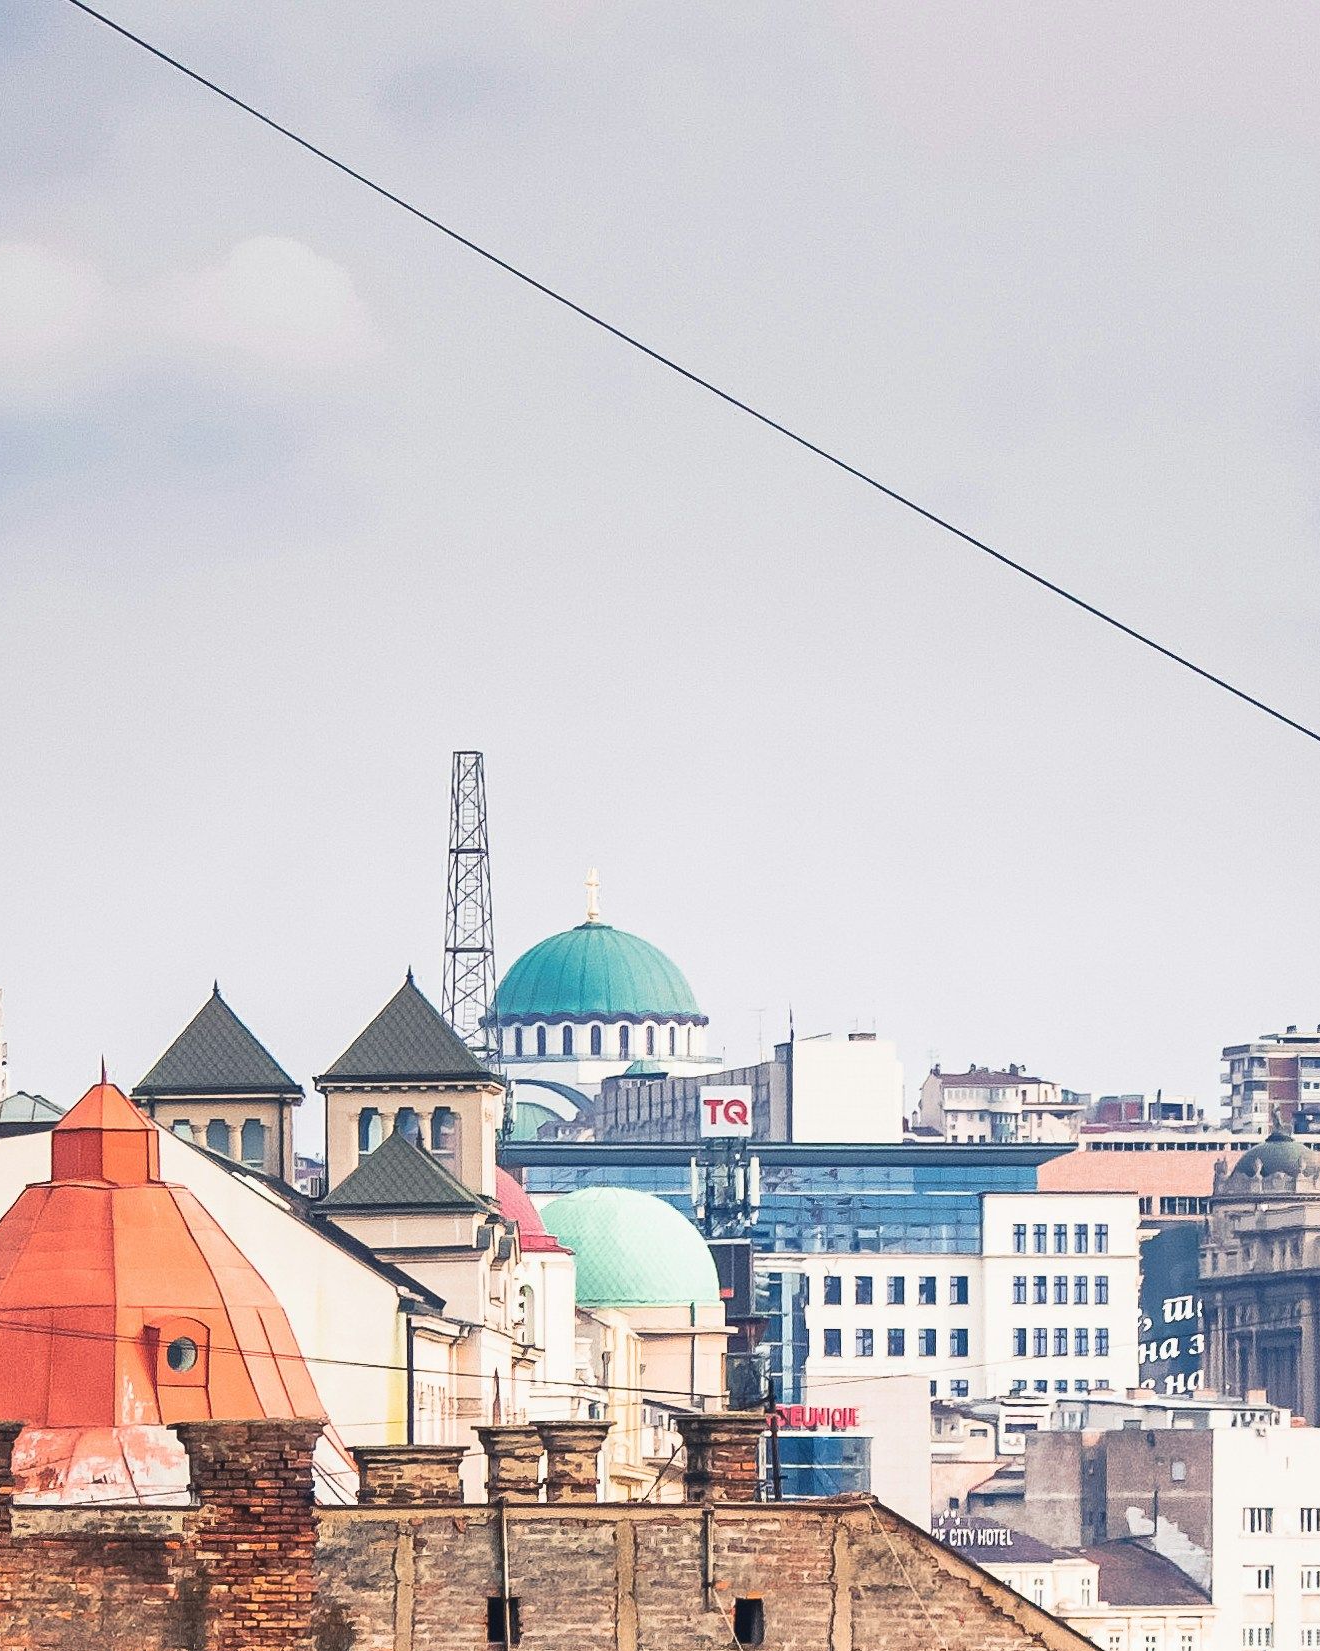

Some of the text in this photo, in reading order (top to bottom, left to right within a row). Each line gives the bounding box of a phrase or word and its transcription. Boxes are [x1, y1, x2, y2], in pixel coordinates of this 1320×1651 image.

[703, 1099, 748, 1125] TQ
[949, 1529, 975, 1546] CITY
[978, 1529, 1013, 1546] HOTEL
